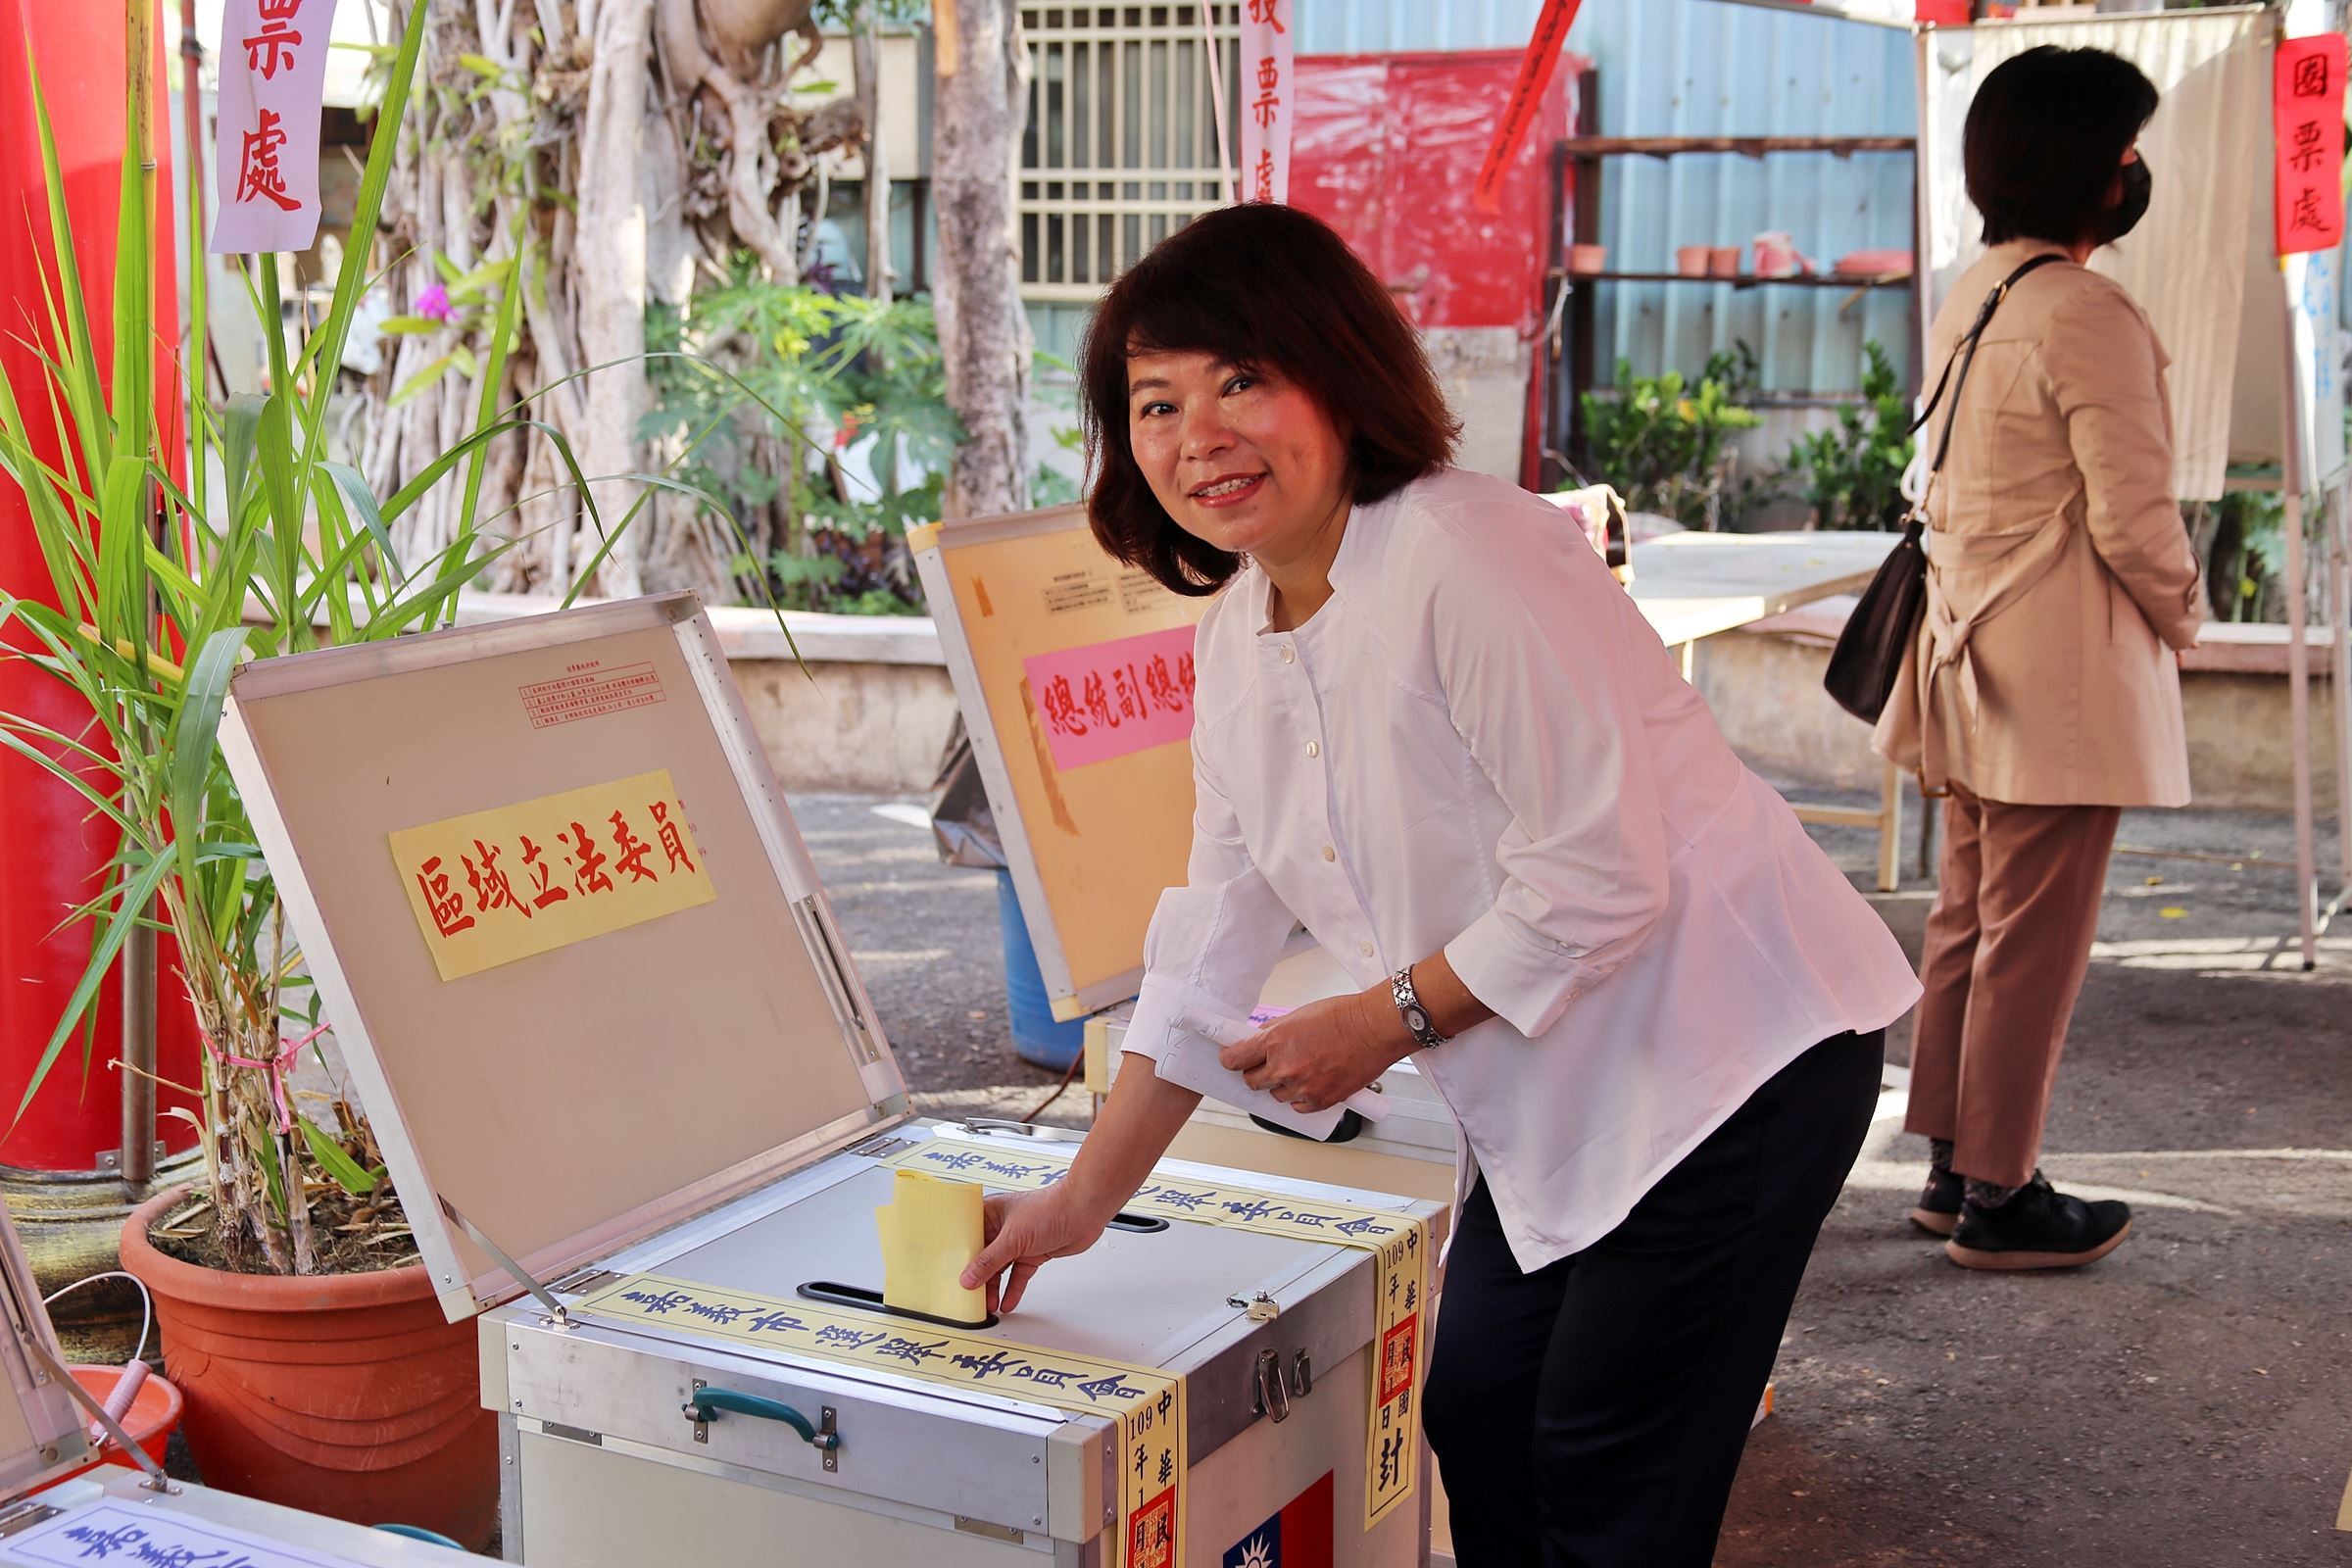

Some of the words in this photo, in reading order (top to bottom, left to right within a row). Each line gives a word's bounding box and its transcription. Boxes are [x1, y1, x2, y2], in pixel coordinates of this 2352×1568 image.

[236, 0, 302, 212] 票處
[2289, 54, 2331, 232] 圈票處
[416, 801, 696, 938] 區域立法委員
[620, 1290, 1146, 1401] 嘉義市選舉委員會
